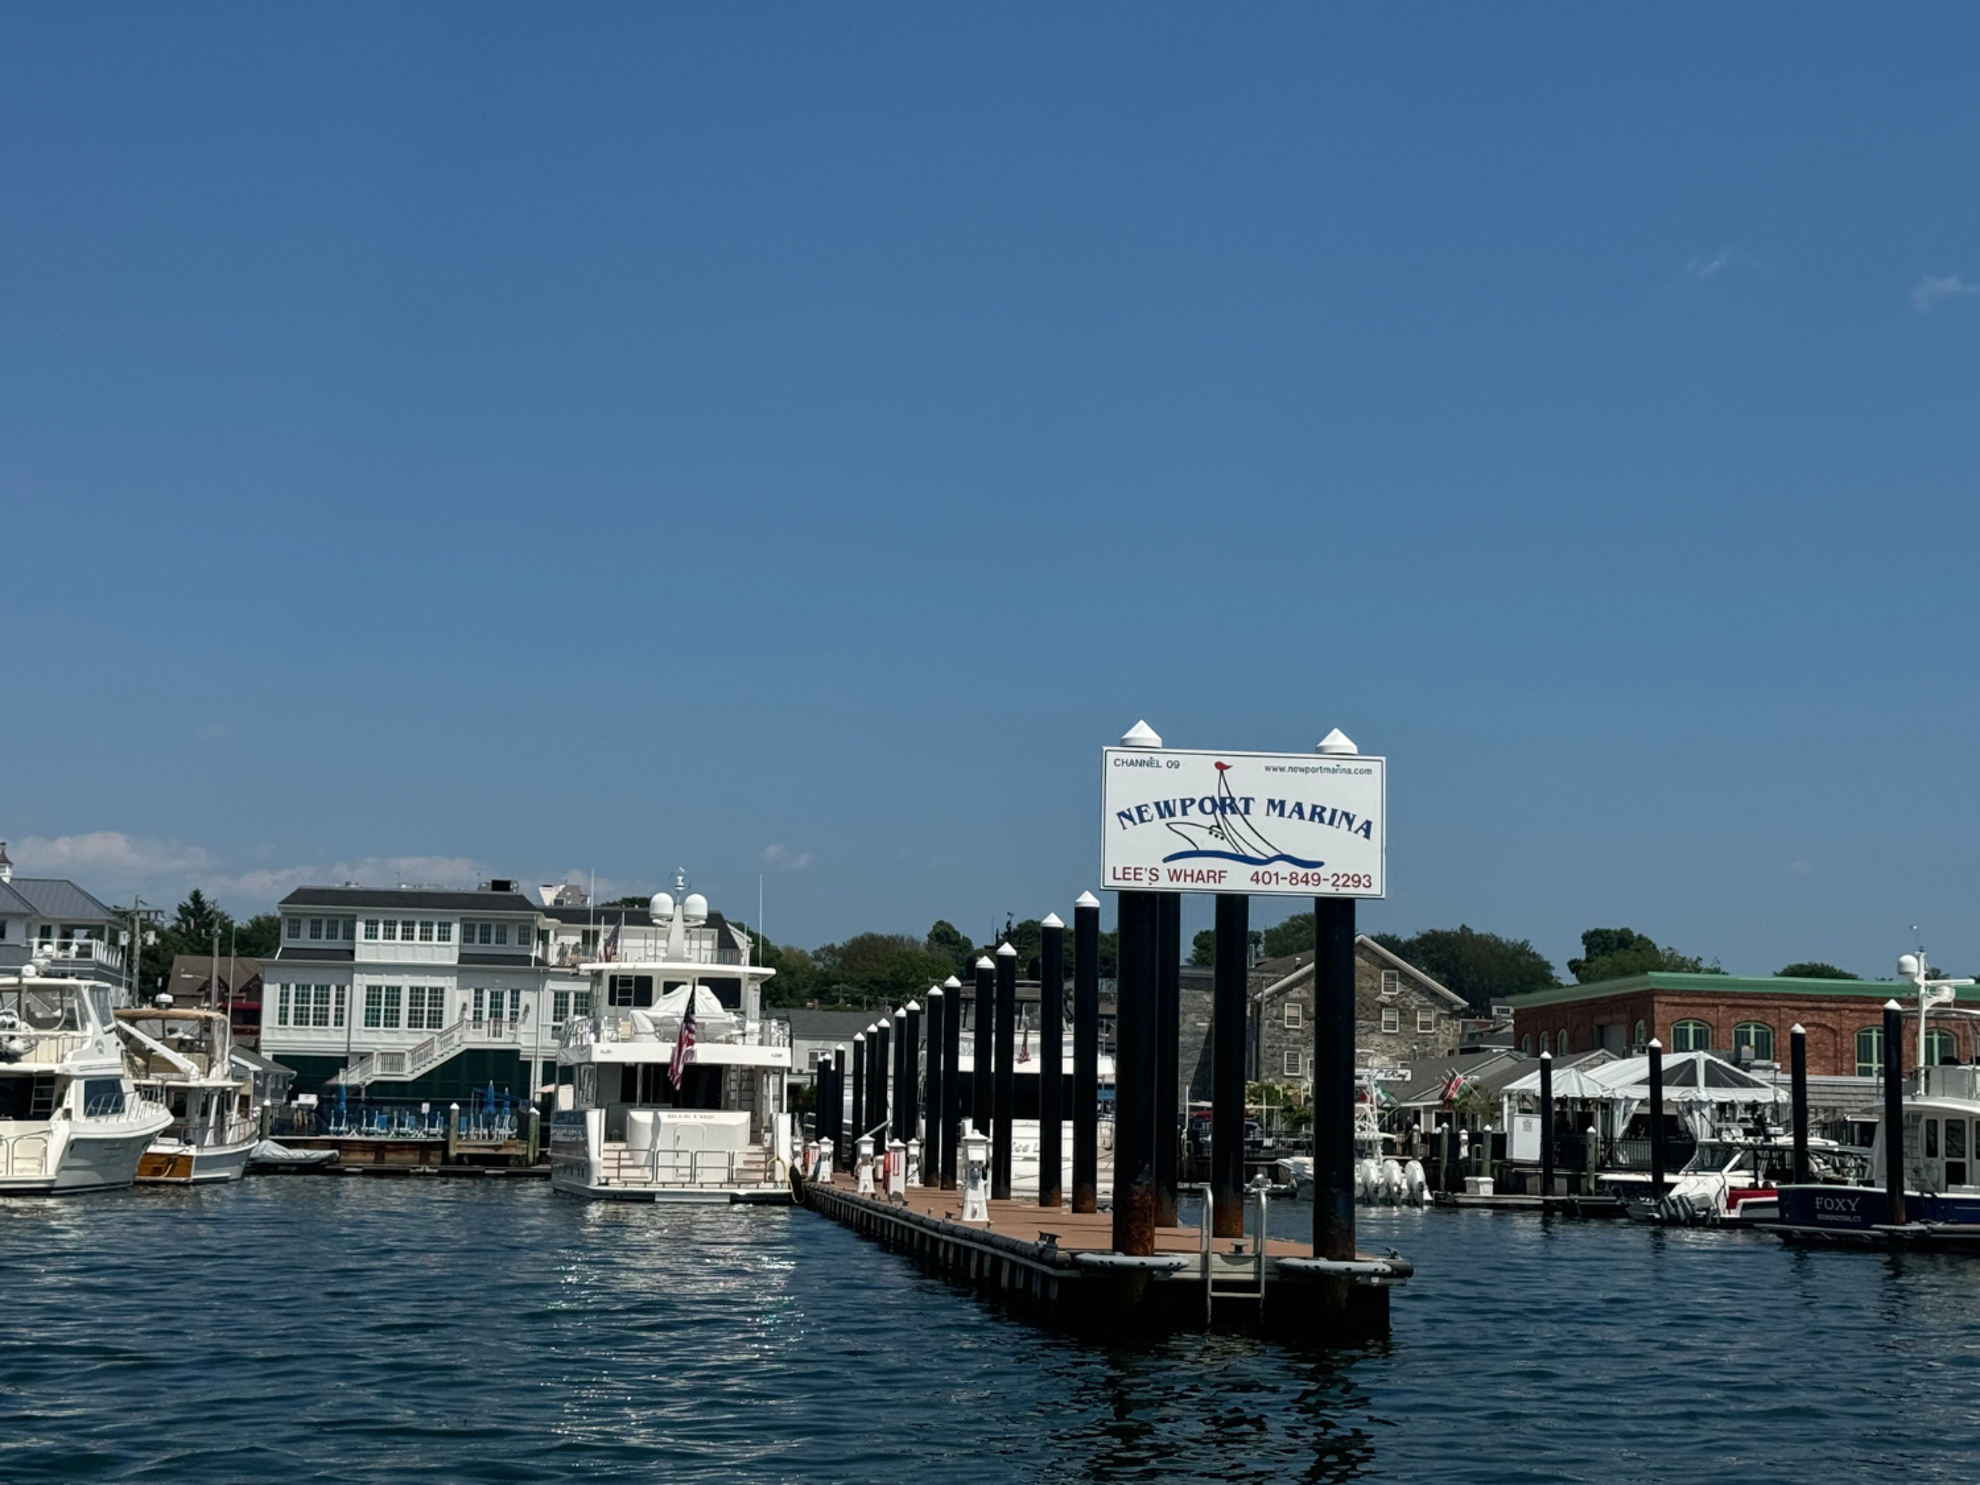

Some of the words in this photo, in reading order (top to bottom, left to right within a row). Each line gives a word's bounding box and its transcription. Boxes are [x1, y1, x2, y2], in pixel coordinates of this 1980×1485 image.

[1113, 758, 1162, 769] CHANNEL
[1166, 760, 1180, 769] 09
[1264, 764, 1373, 776] www.newportmarina.com
[1116, 796, 1256, 831] NEWPORT
[1265, 798, 1374, 841] MARINA
[1112, 866, 1160, 882] LEE'S
[1167, 868, 1228, 884] WHARF
[1250, 870, 1373, 888] 401-849-2293
[1815, 1196, 1862, 1212] FOXY
